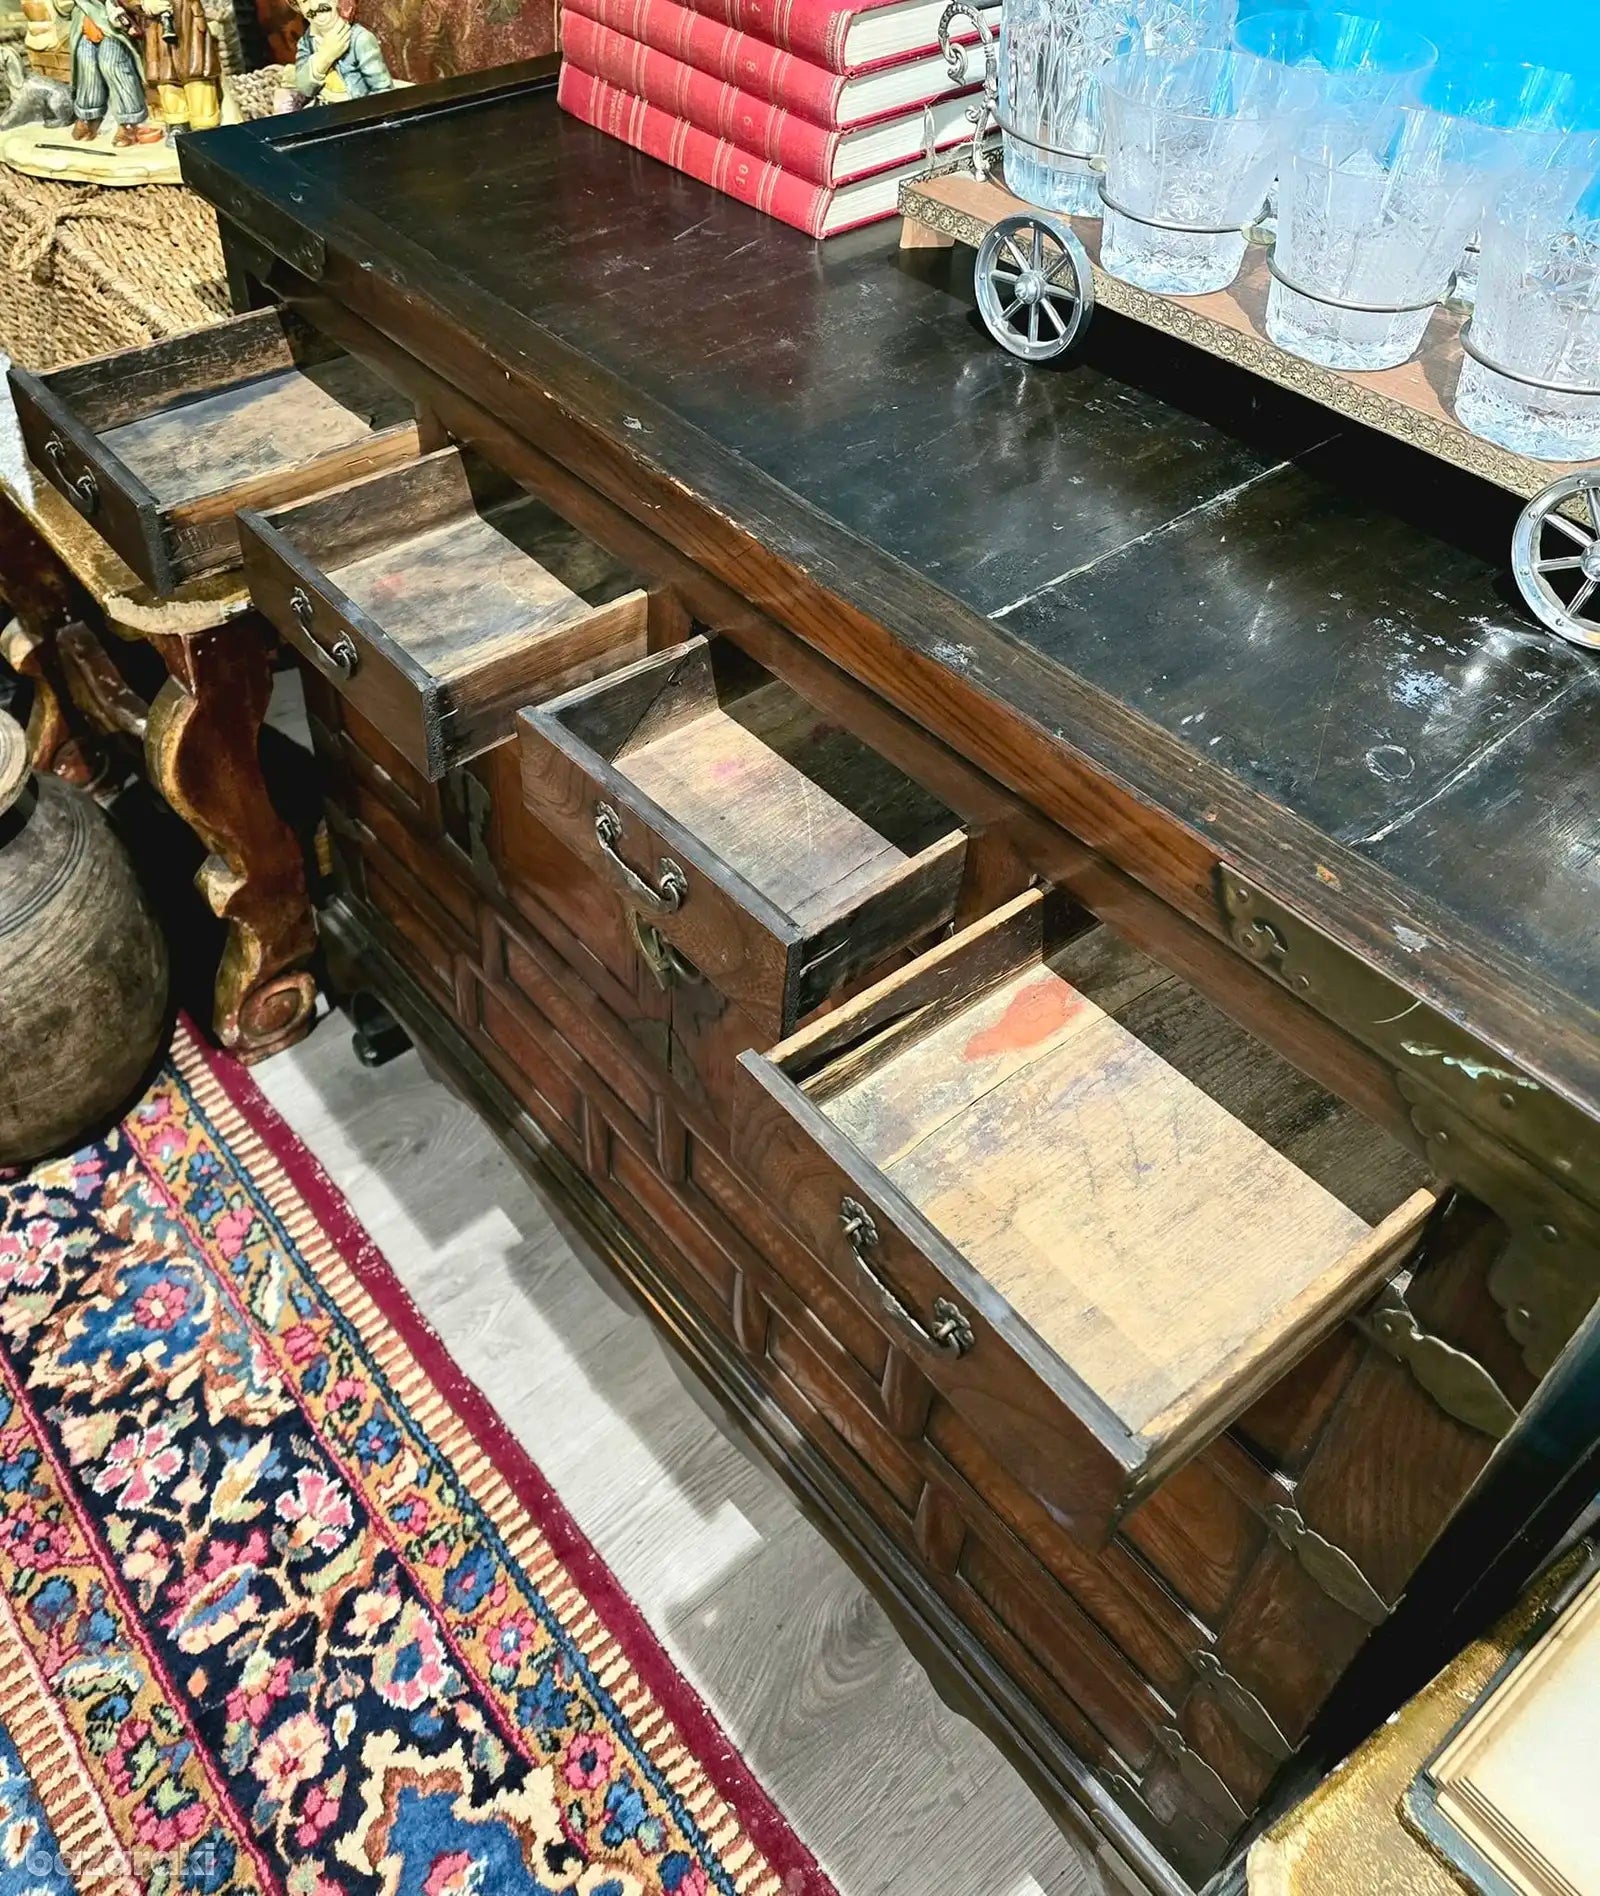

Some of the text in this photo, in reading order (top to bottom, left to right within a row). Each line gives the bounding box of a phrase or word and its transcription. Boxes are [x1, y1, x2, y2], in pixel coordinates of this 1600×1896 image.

[751, 1, 761, 12] 7
[746, 61, 757, 73] 8
[743, 115, 754, 128] 9
[735, 163, 749, 185] 10
